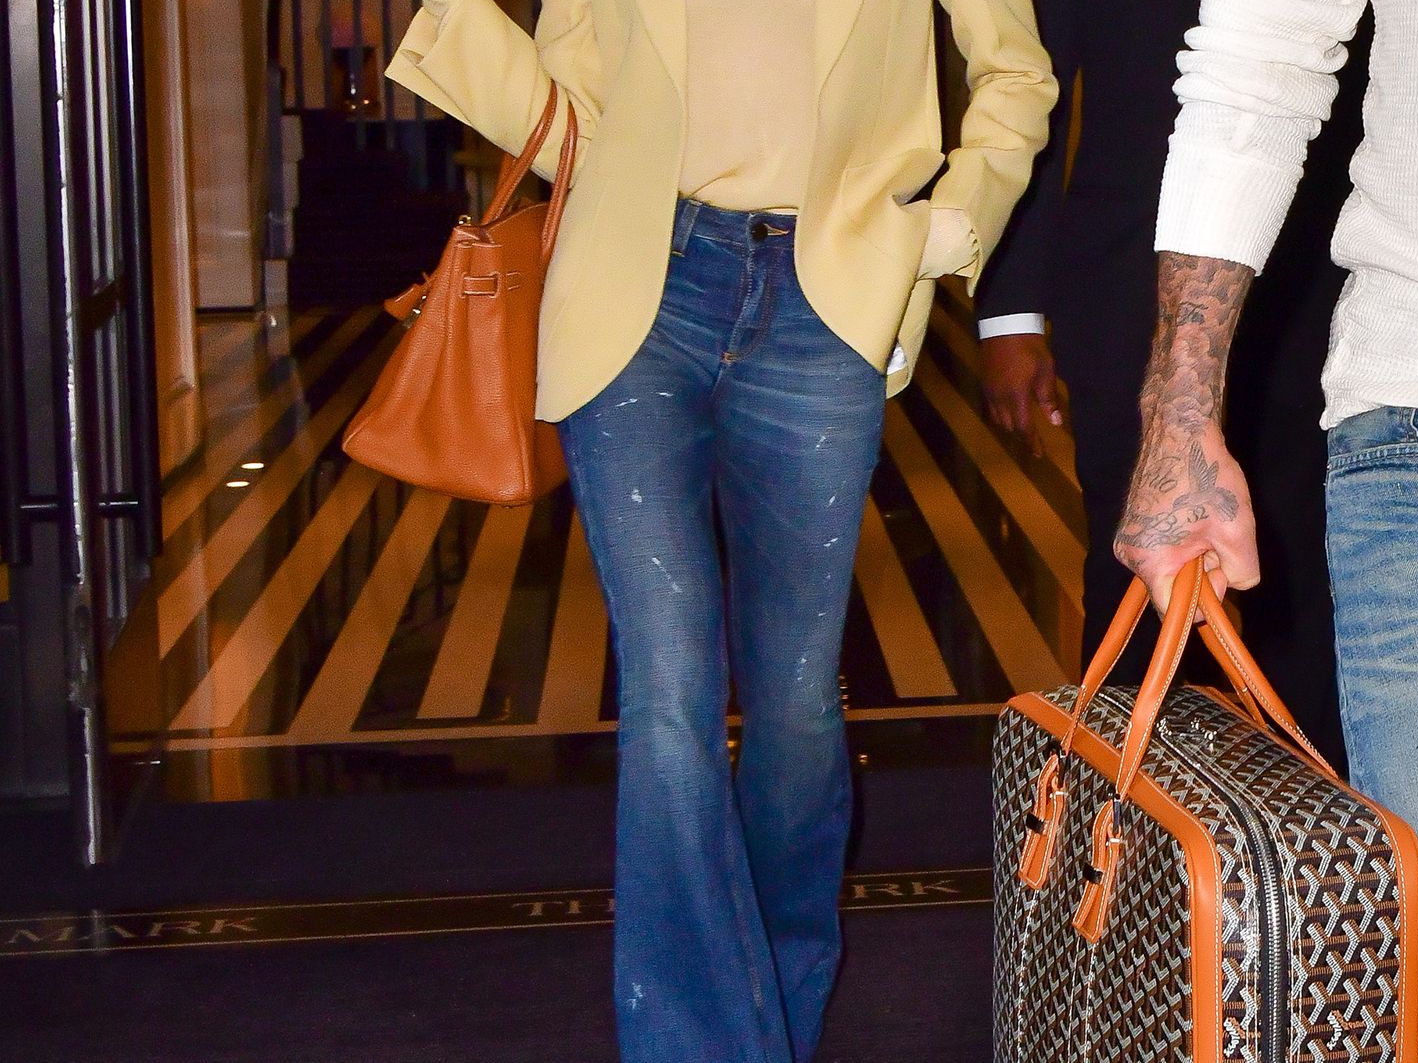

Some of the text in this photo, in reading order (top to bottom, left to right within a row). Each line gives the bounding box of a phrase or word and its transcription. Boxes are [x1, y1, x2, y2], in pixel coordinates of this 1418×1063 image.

[512, 879, 960, 917] TH RK
[8, 917, 258, 944] MARK
